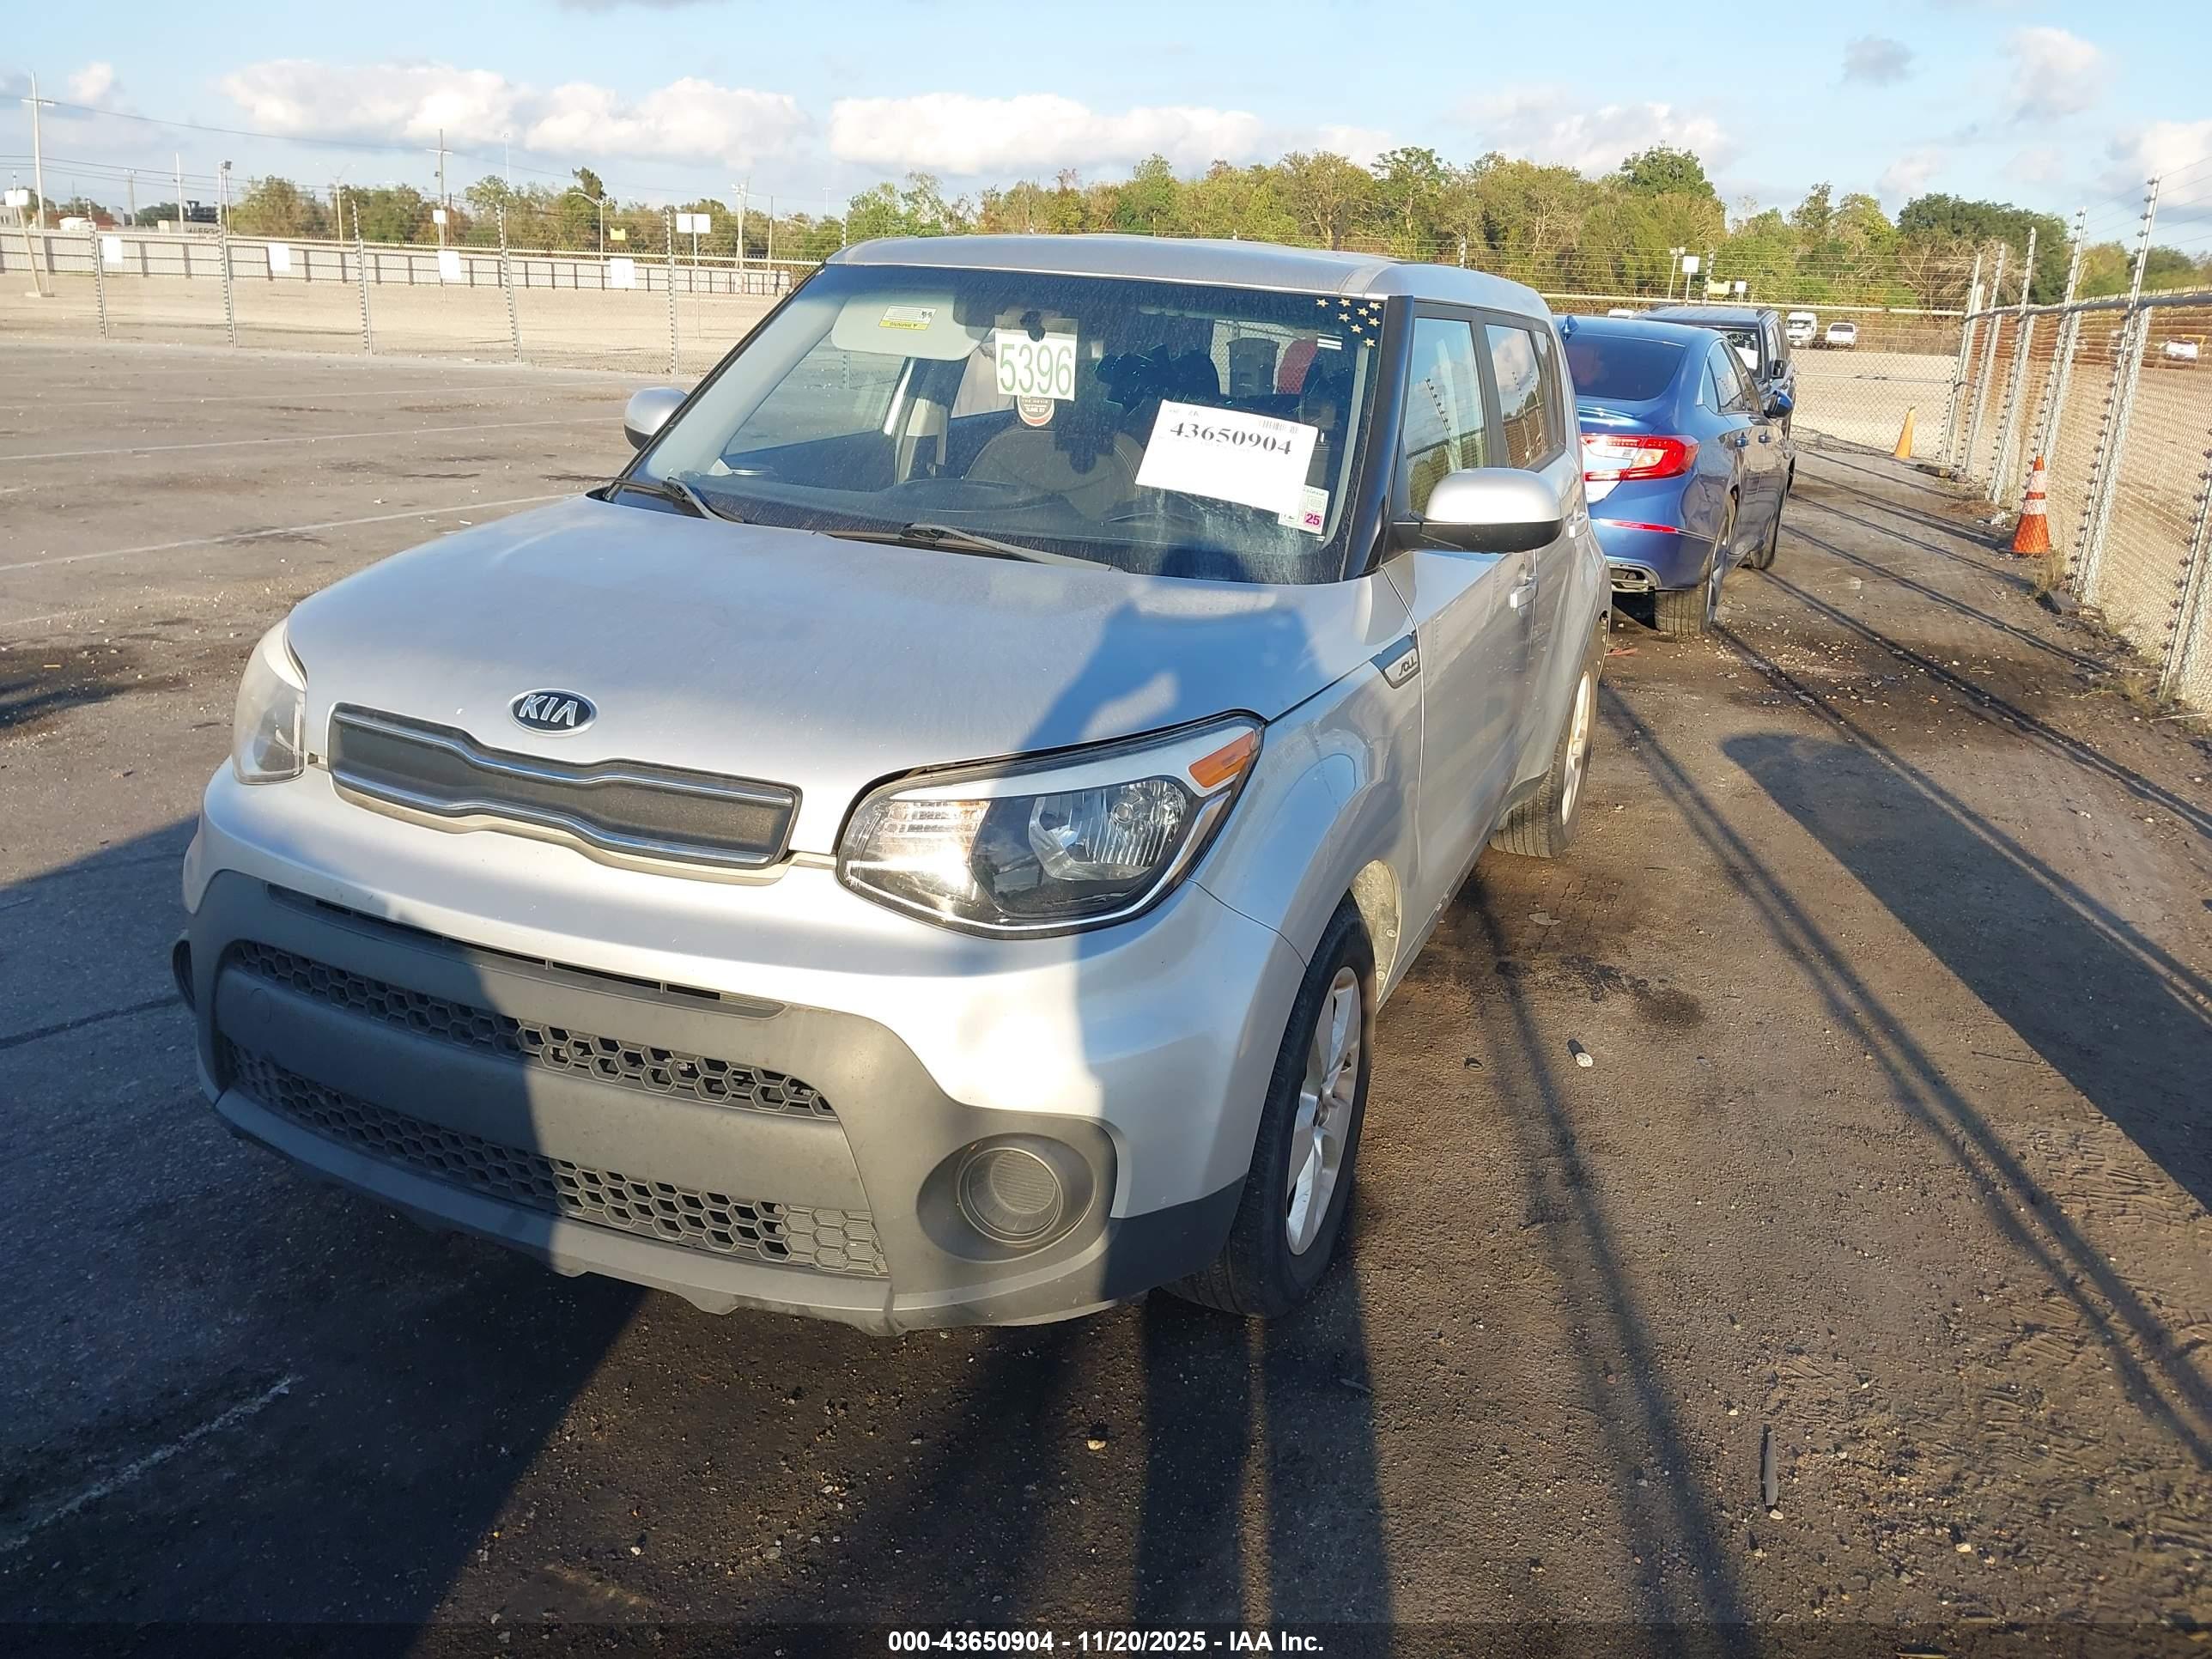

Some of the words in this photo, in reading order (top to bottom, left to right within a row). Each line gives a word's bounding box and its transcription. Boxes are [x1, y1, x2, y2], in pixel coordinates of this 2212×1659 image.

[1000, 343, 1072, 396] 5396
[1170, 422, 1292, 454] 43650904
[1305, 513, 1321, 526] 25
[518, 695, 578, 726] KIA
